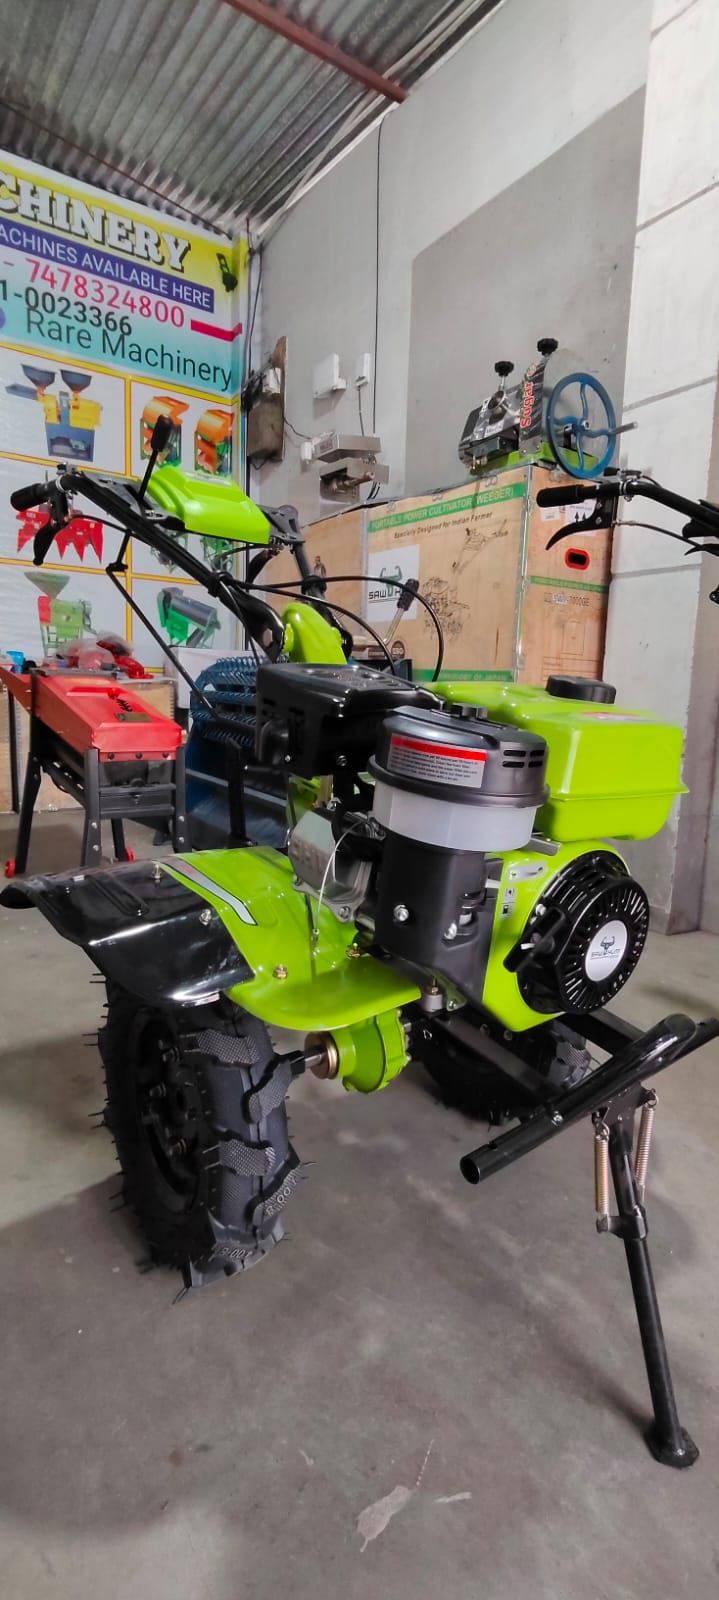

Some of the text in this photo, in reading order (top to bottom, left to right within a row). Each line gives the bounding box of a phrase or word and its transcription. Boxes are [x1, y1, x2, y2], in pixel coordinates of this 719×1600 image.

[25, 258, 185, 328] 7478324800
[82, 252, 169, 295] AVAILABLE
[172, 284, 211, 309] HERE
[26, 306, 232, 391] Rare Machinery
[519, 381, 535, 429] Sugar
[371, 487, 514, 529] PORTABLE POWER CULTIVATOR WEEDER)
[416, 523, 442, 535] Designed
[442, 521, 452, 530] for
[452, 517, 470, 527] Indian
[470, 511, 493, 523] Farmer
